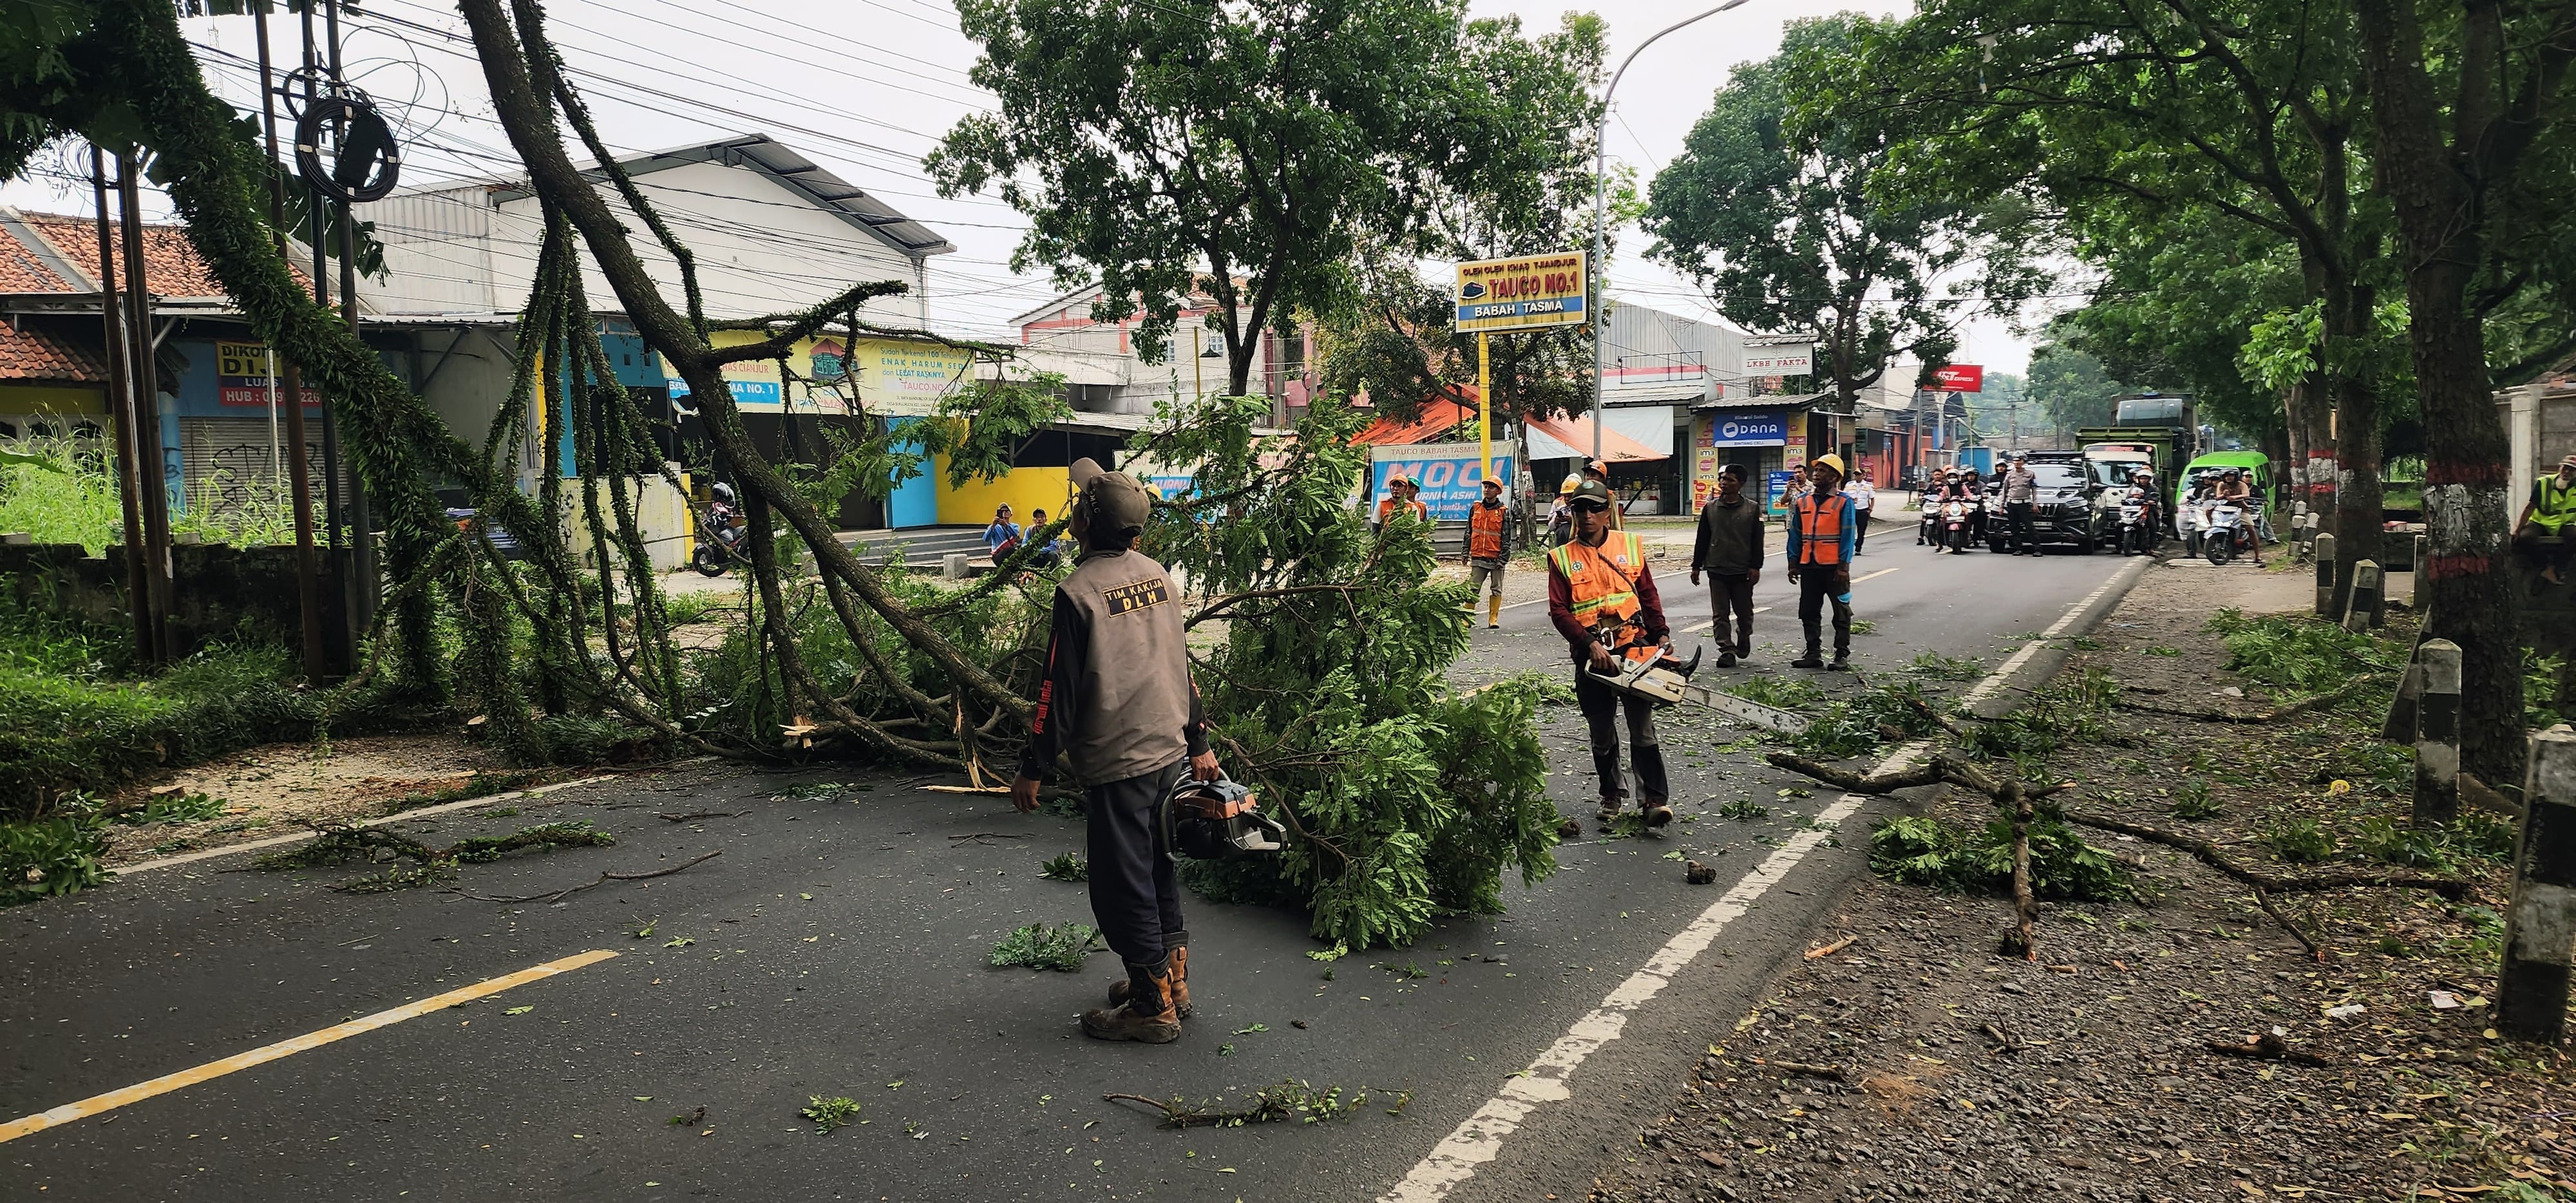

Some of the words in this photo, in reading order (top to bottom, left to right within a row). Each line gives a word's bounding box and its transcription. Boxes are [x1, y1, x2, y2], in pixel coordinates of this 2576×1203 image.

[1463, 267, 1483, 276] OLEH
[1484, 265, 1504, 274] OLEH
[1507, 262, 1530, 272] KHAS
[1533, 258, 1577, 270] TJIANDJUR
[1488, 275, 1540, 299] TAUCO
[1544, 270, 1577, 294] NO.1
[1475, 304, 1515, 317] BABAH
[1523, 300, 1564, 314] TASMA
[881, 357, 906, 366] ENAK
[912, 360, 943, 368] HARUM
[739, 363, 769, 374] CIANJUR
[916, 370, 945, 379] RASANYA
[747, 384, 765, 394] NO.
[768, 384, 773, 394] 1
[226, 391, 252, 402] HUB
[1740, 424, 1778, 435] DANA
[1391, 448, 1418, 456] TAUCO
[1421, 446, 1448, 455] BABAH
[1450, 446, 1476, 454] TASMA
[1449, 491, 1477, 500] ASIH
[1105, 590, 1126, 601] TIM
[1128, 580, 1164, 596] KAKIJA
